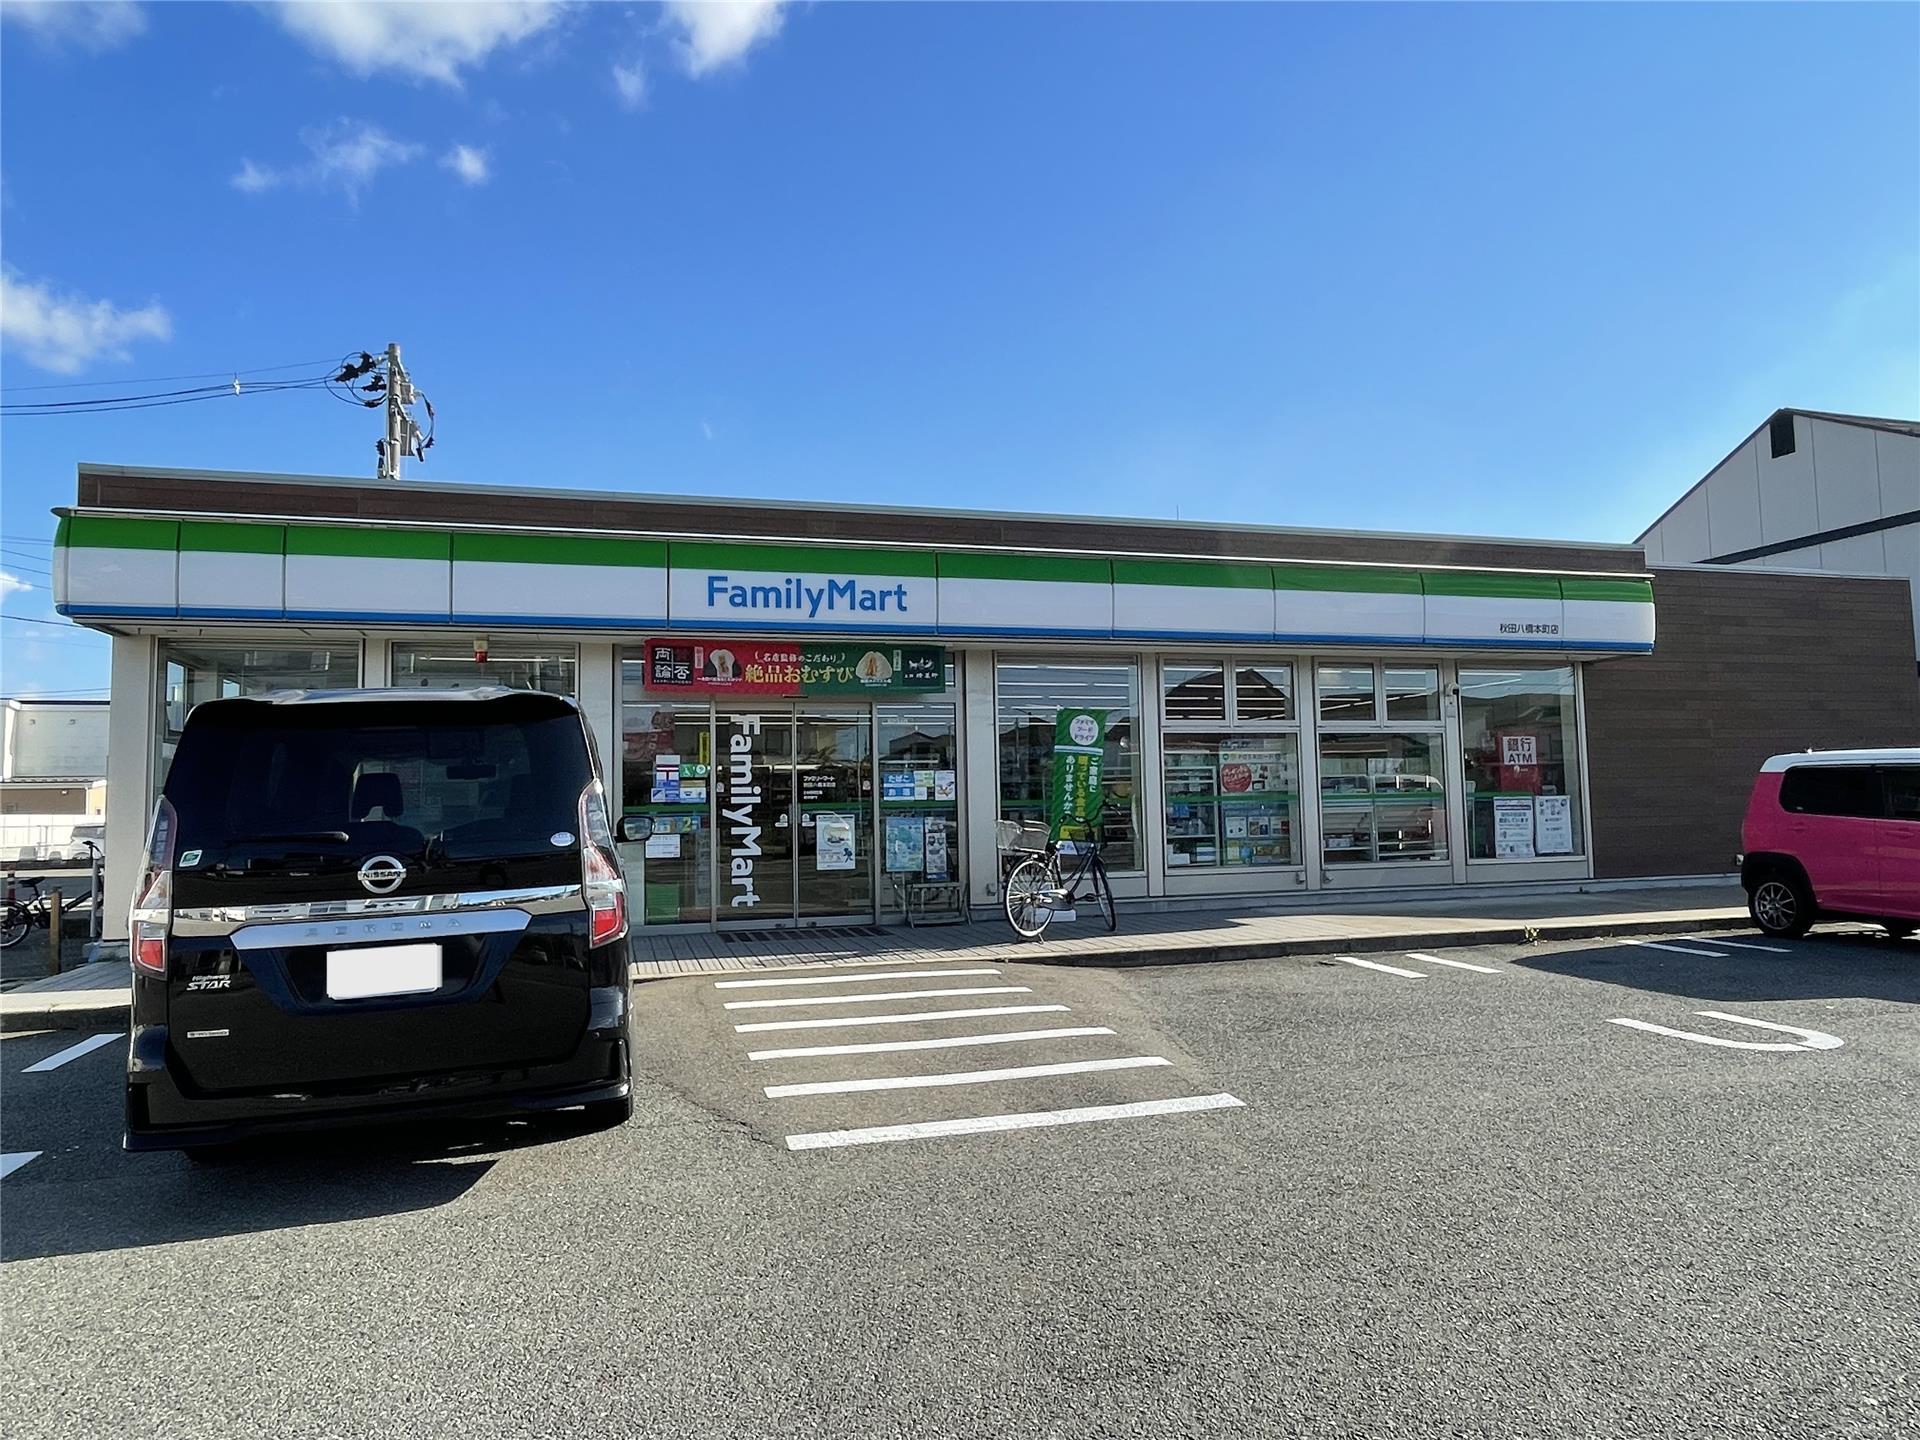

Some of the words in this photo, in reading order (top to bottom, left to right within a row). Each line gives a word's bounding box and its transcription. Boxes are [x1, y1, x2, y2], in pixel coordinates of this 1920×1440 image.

[707, 575, 908, 618] FamilyMart
[1499, 623, 1559, 635] 秋田八橋本町店
[744, 663, 855, 684] 絶品おむすび
[1507, 737, 1532, 752] 銀行
[1508, 753, 1533, 763] ATM
[888, 775, 911, 783] たばこ
[721, 713, 762, 908] FamilyMart
[362, 871, 401, 880] NISSAN
[304, 918, 461, 938] SERENA
[186, 980, 231, 991] STAR
